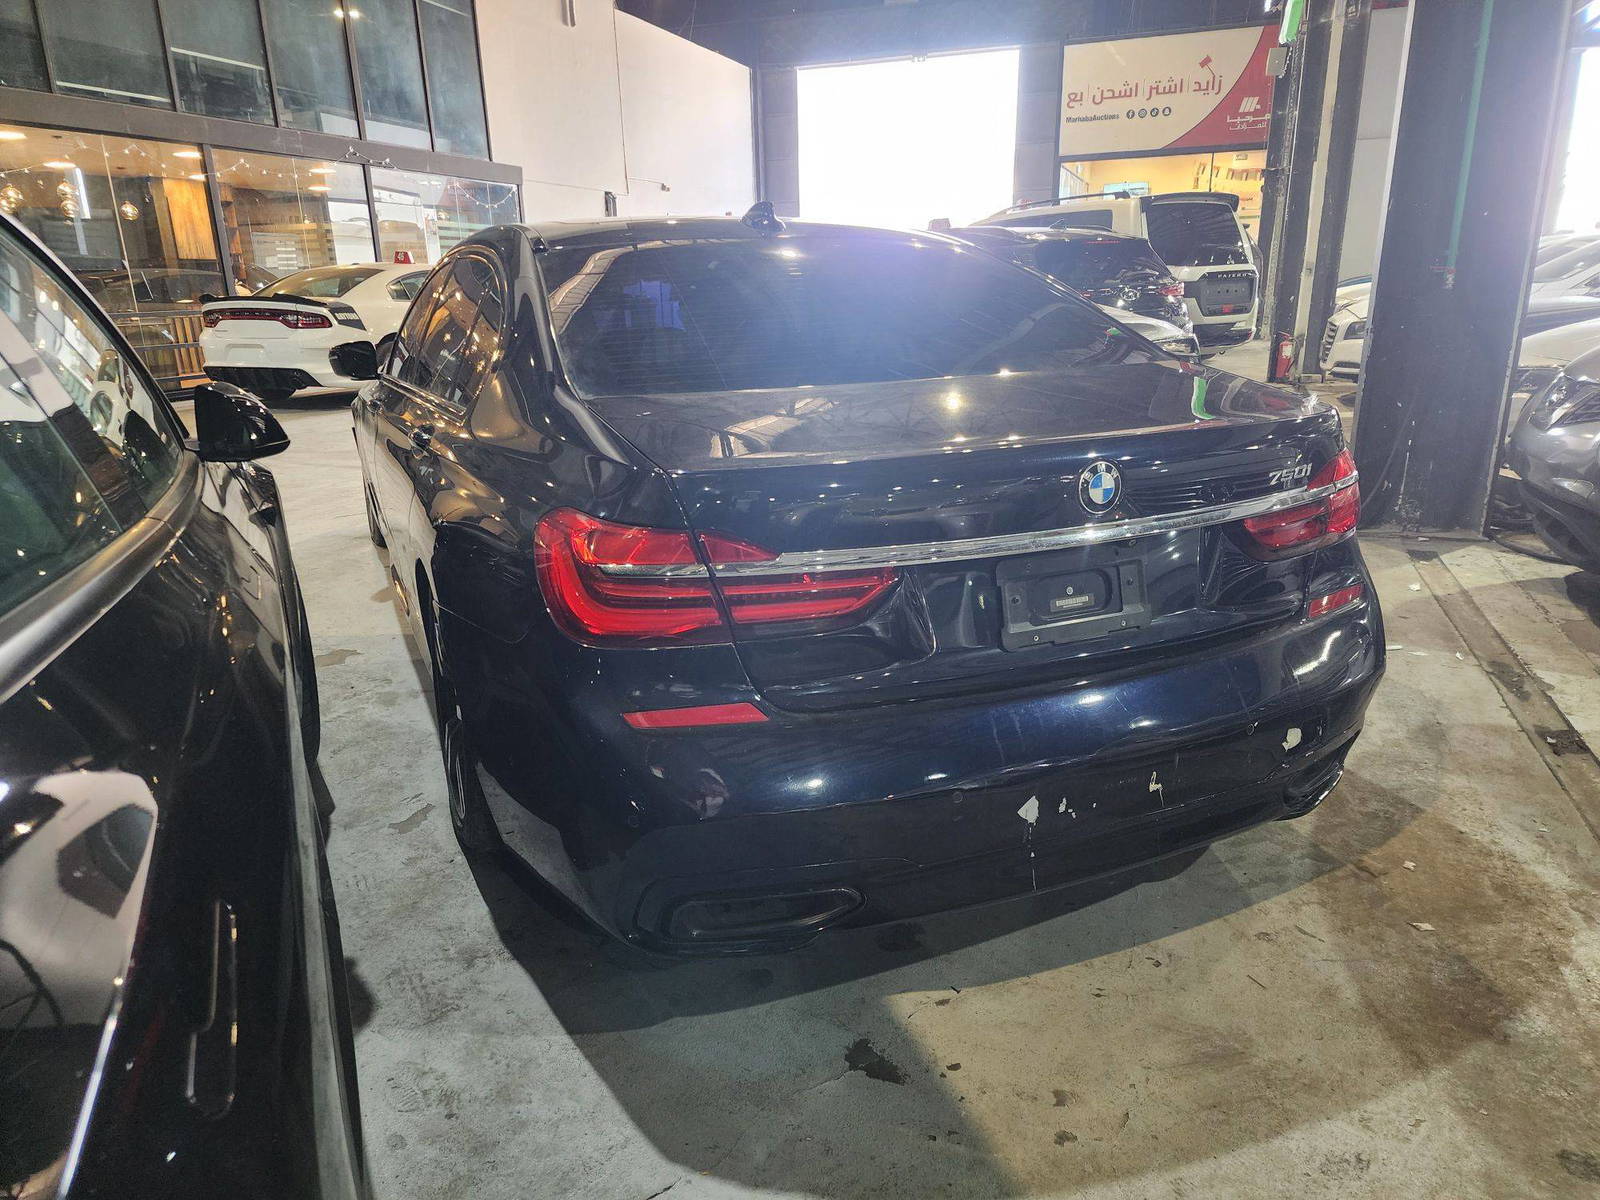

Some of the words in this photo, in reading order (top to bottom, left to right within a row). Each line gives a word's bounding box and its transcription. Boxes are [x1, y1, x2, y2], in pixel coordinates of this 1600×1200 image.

[1092, 80, 1139, 105] اشحن
[1146, 76, 1184, 101] اشتر
[1192, 73, 1224, 96] زايد
[1066, 91, 1083, 109] بع
[1065, 113, 1120, 123] MarhabaAuctions
